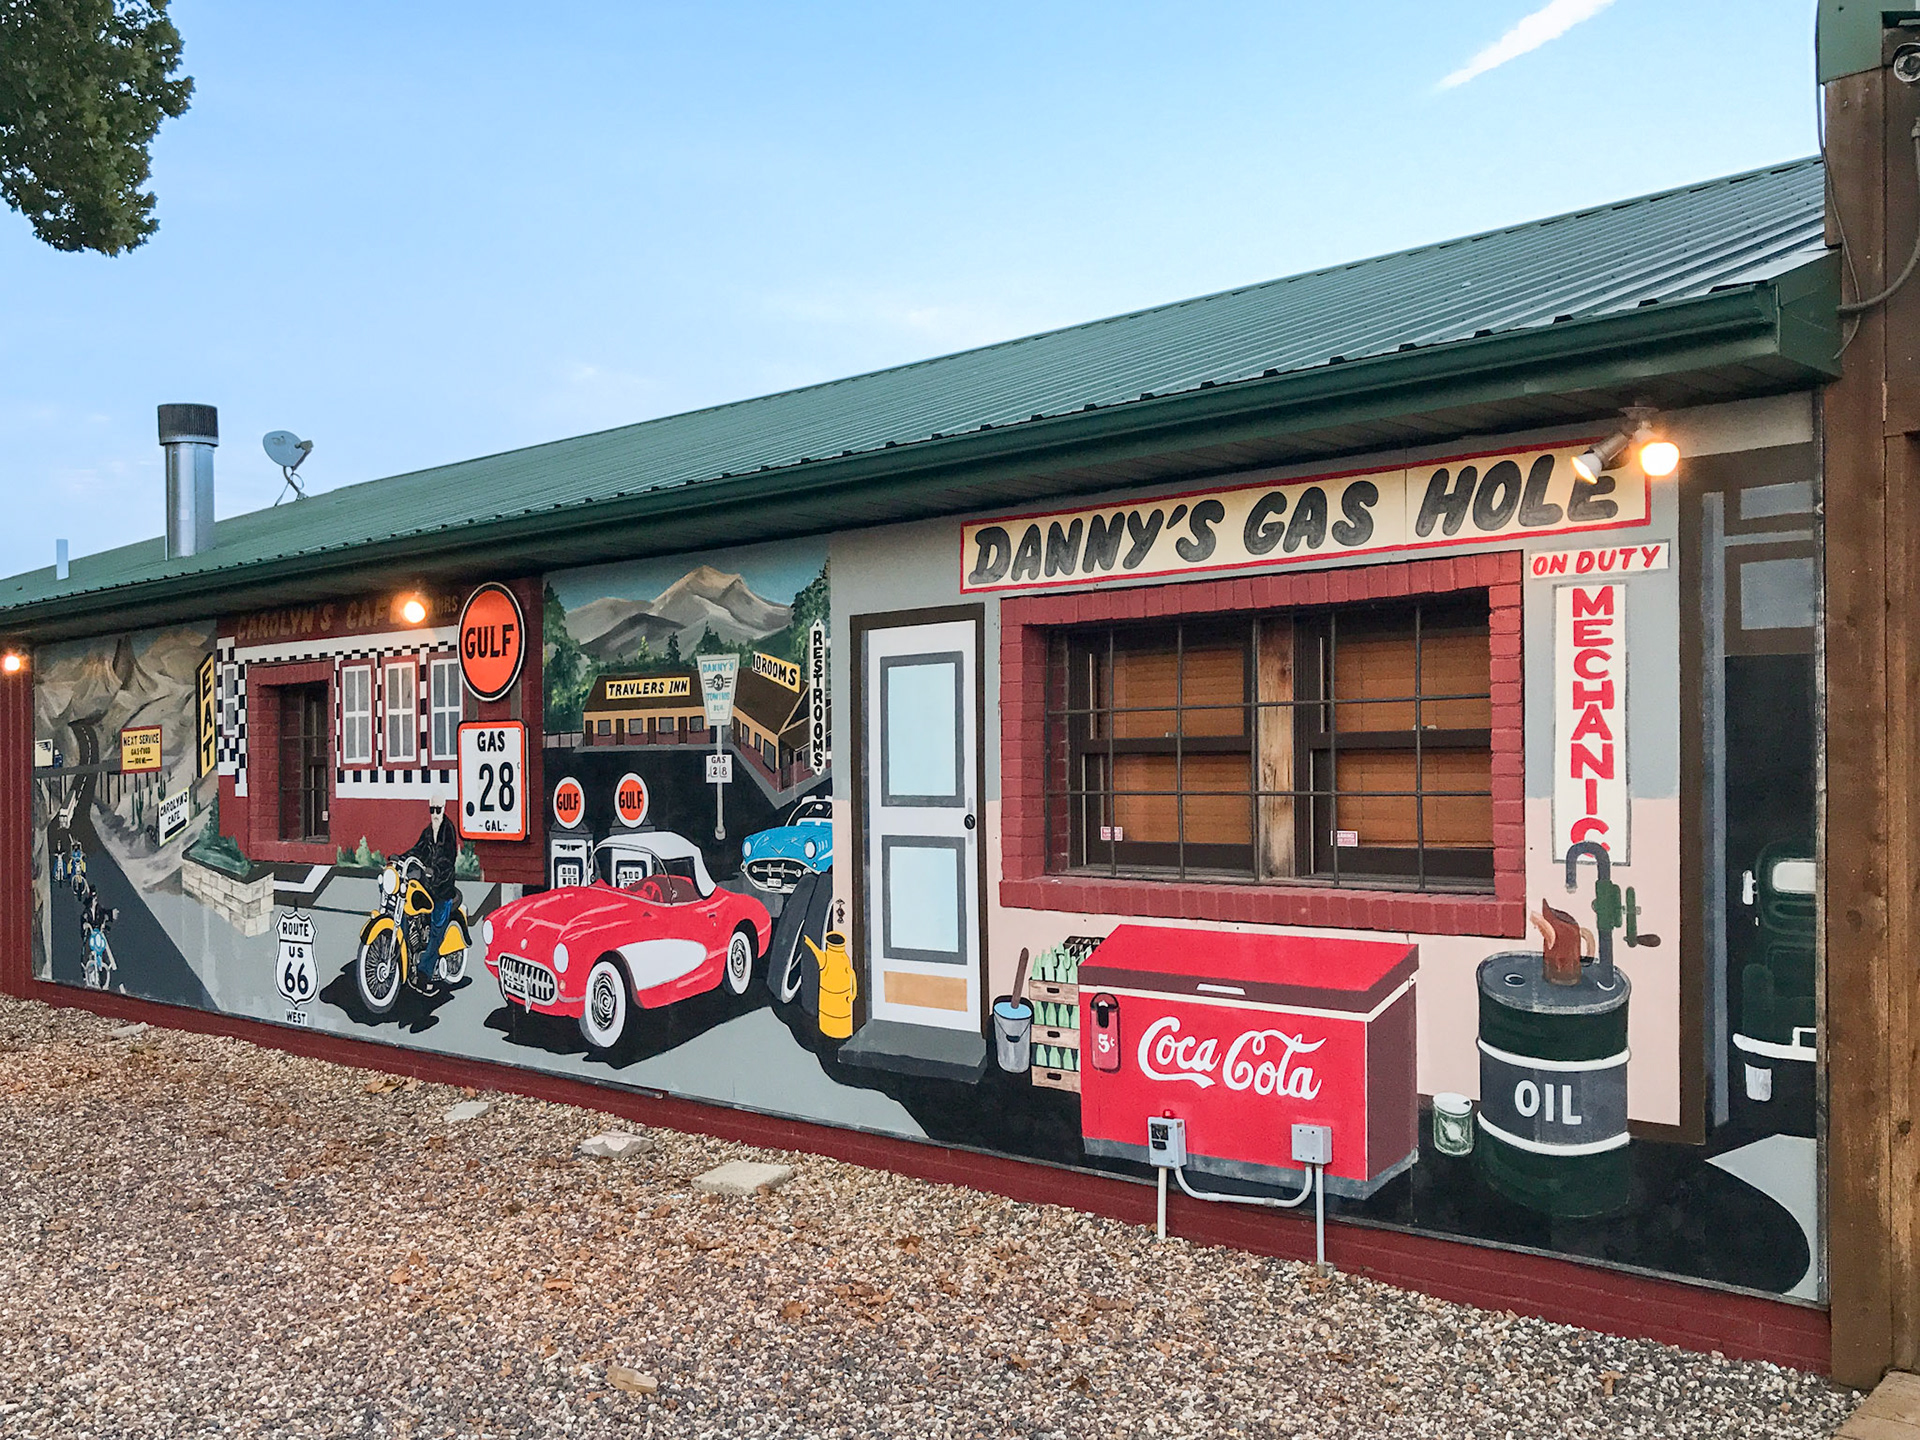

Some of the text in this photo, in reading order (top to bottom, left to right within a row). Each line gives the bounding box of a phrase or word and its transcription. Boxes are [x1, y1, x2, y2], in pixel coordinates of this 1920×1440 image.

[968, 453, 1619, 586] DANNY'S GAS HOLE
[1532, 545, 1661, 576] ON DUTY
[464, 623, 514, 660] GULF
[608, 680, 688, 697] TRAVLERS INN
[713, 677, 723, 688] 24
[813, 629, 823, 767] RESTROOMS
[201, 663, 212, 768] EAT
[1570, 585, 1614, 859] MECHANIC
[123, 733, 159, 746] NEXT SERVICE
[477, 730, 506, 753] GAS
[711, 756, 727, 764] GAS
[160, 791, 188, 818] CAROLYN'S
[556, 792, 579, 811] GULF
[618, 788, 643, 809] GULF
[282, 922, 310, 937] ROUTE
[288, 945, 304, 958] US
[284, 961, 309, 995] 66
[286, 1011, 306, 1024] WEST
[1137, 1015, 1327, 1101] Coca Cola
[1514, 1079, 1582, 1126] OIL
